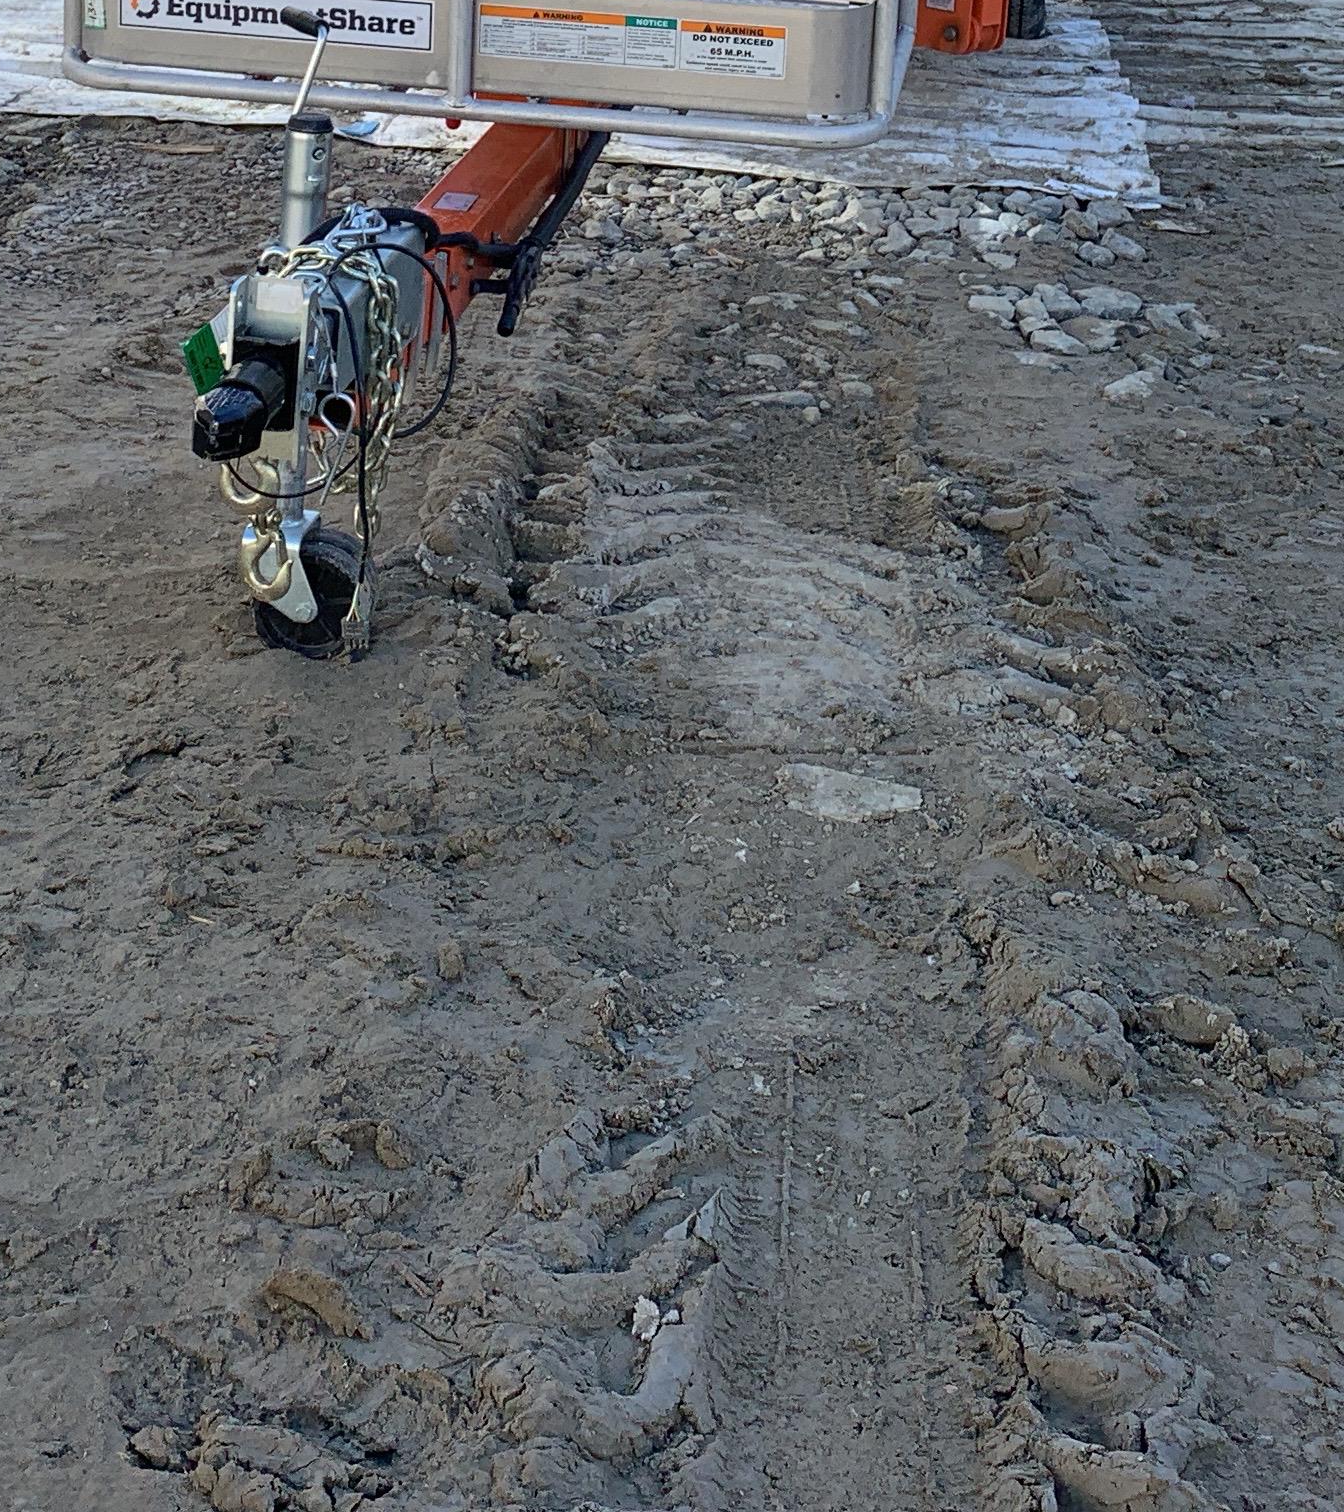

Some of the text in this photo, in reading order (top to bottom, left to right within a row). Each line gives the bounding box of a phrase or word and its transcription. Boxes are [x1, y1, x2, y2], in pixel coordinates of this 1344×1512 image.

[542, 12, 584, 21] WARNING
[635, 18, 669, 28] NOTICE
[716, 25, 764, 37] WARNING
[693, 34, 774, 47] DO NOT EXCEED
[710, 48, 755, 58] 65 M.P.H.
